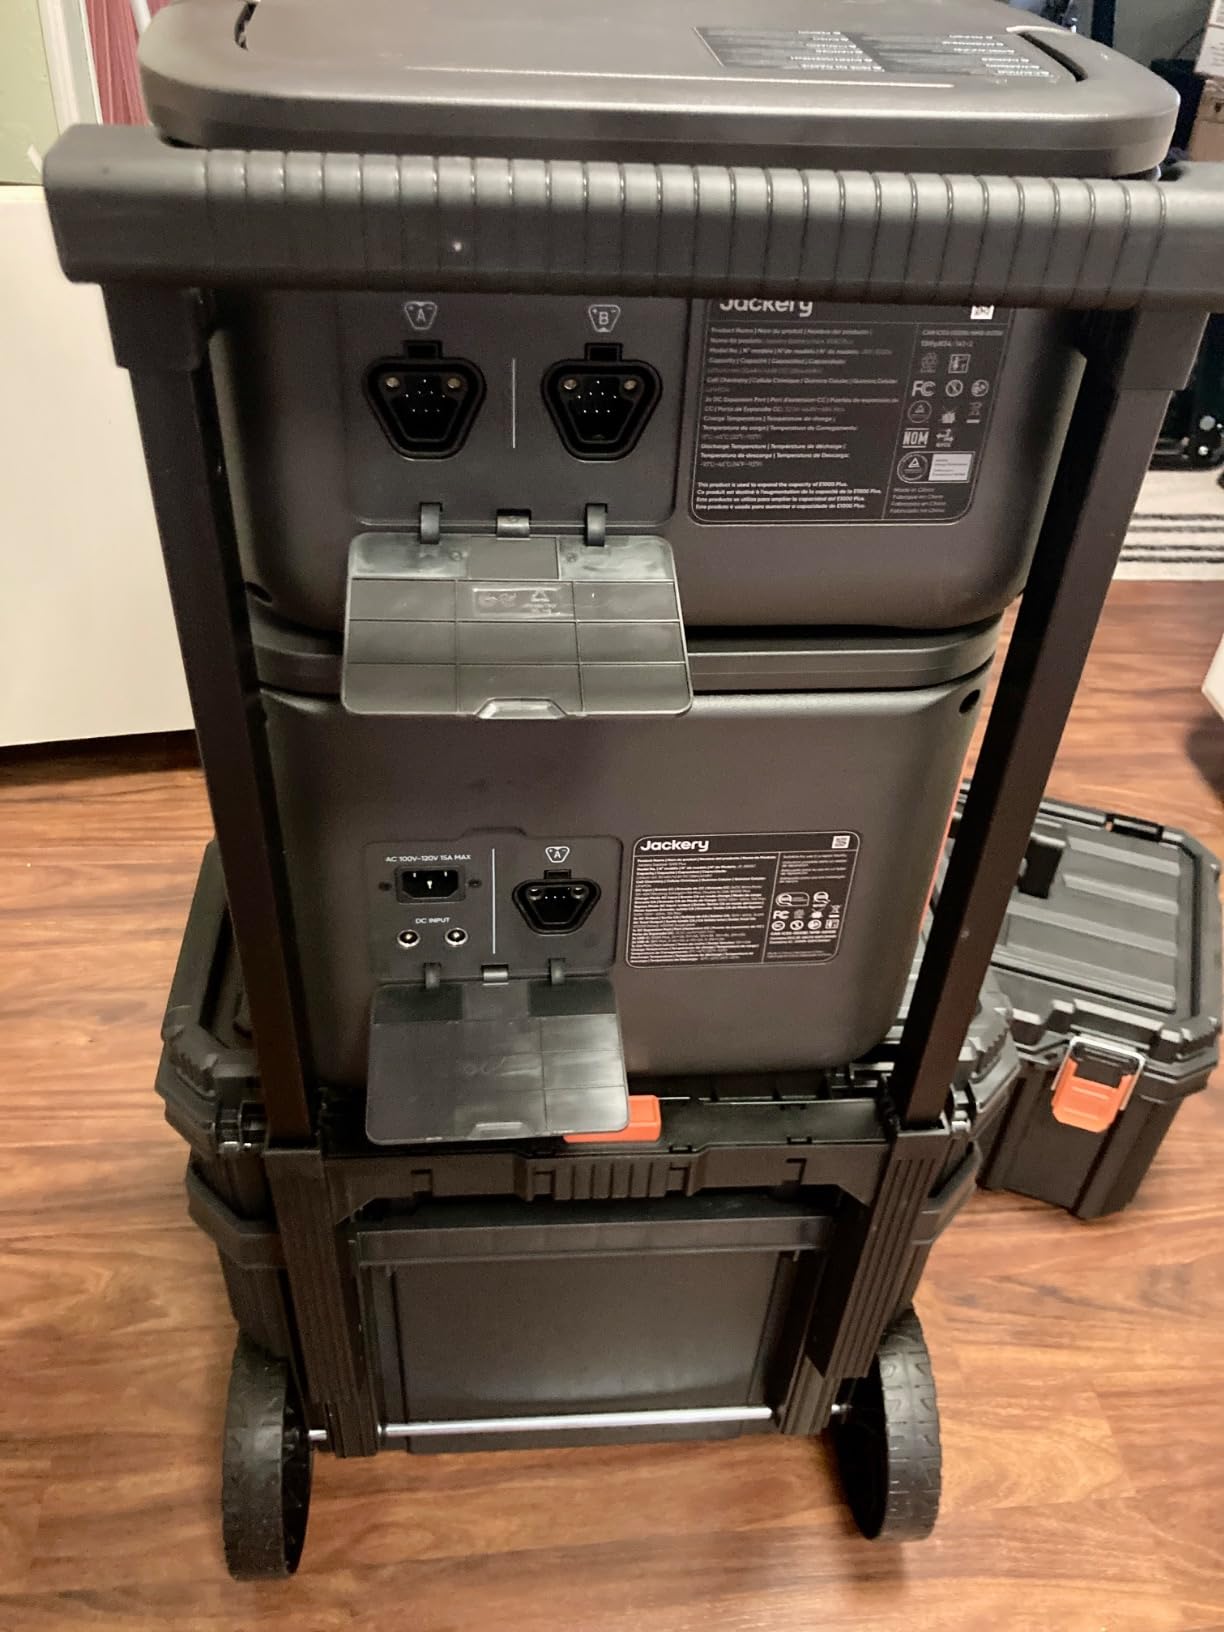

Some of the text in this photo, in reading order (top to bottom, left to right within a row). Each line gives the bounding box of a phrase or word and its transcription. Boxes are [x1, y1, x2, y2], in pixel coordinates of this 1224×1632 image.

[415, 308, 427, 323] A
[720, 298, 813, 318] Jackery
[598, 310, 609, 326] B
[902, 431, 929, 446] NOM
[640, 839, 710, 853] Jackery
[553, 850, 562, 859] A
[428, 916, 450, 924] INPUT
